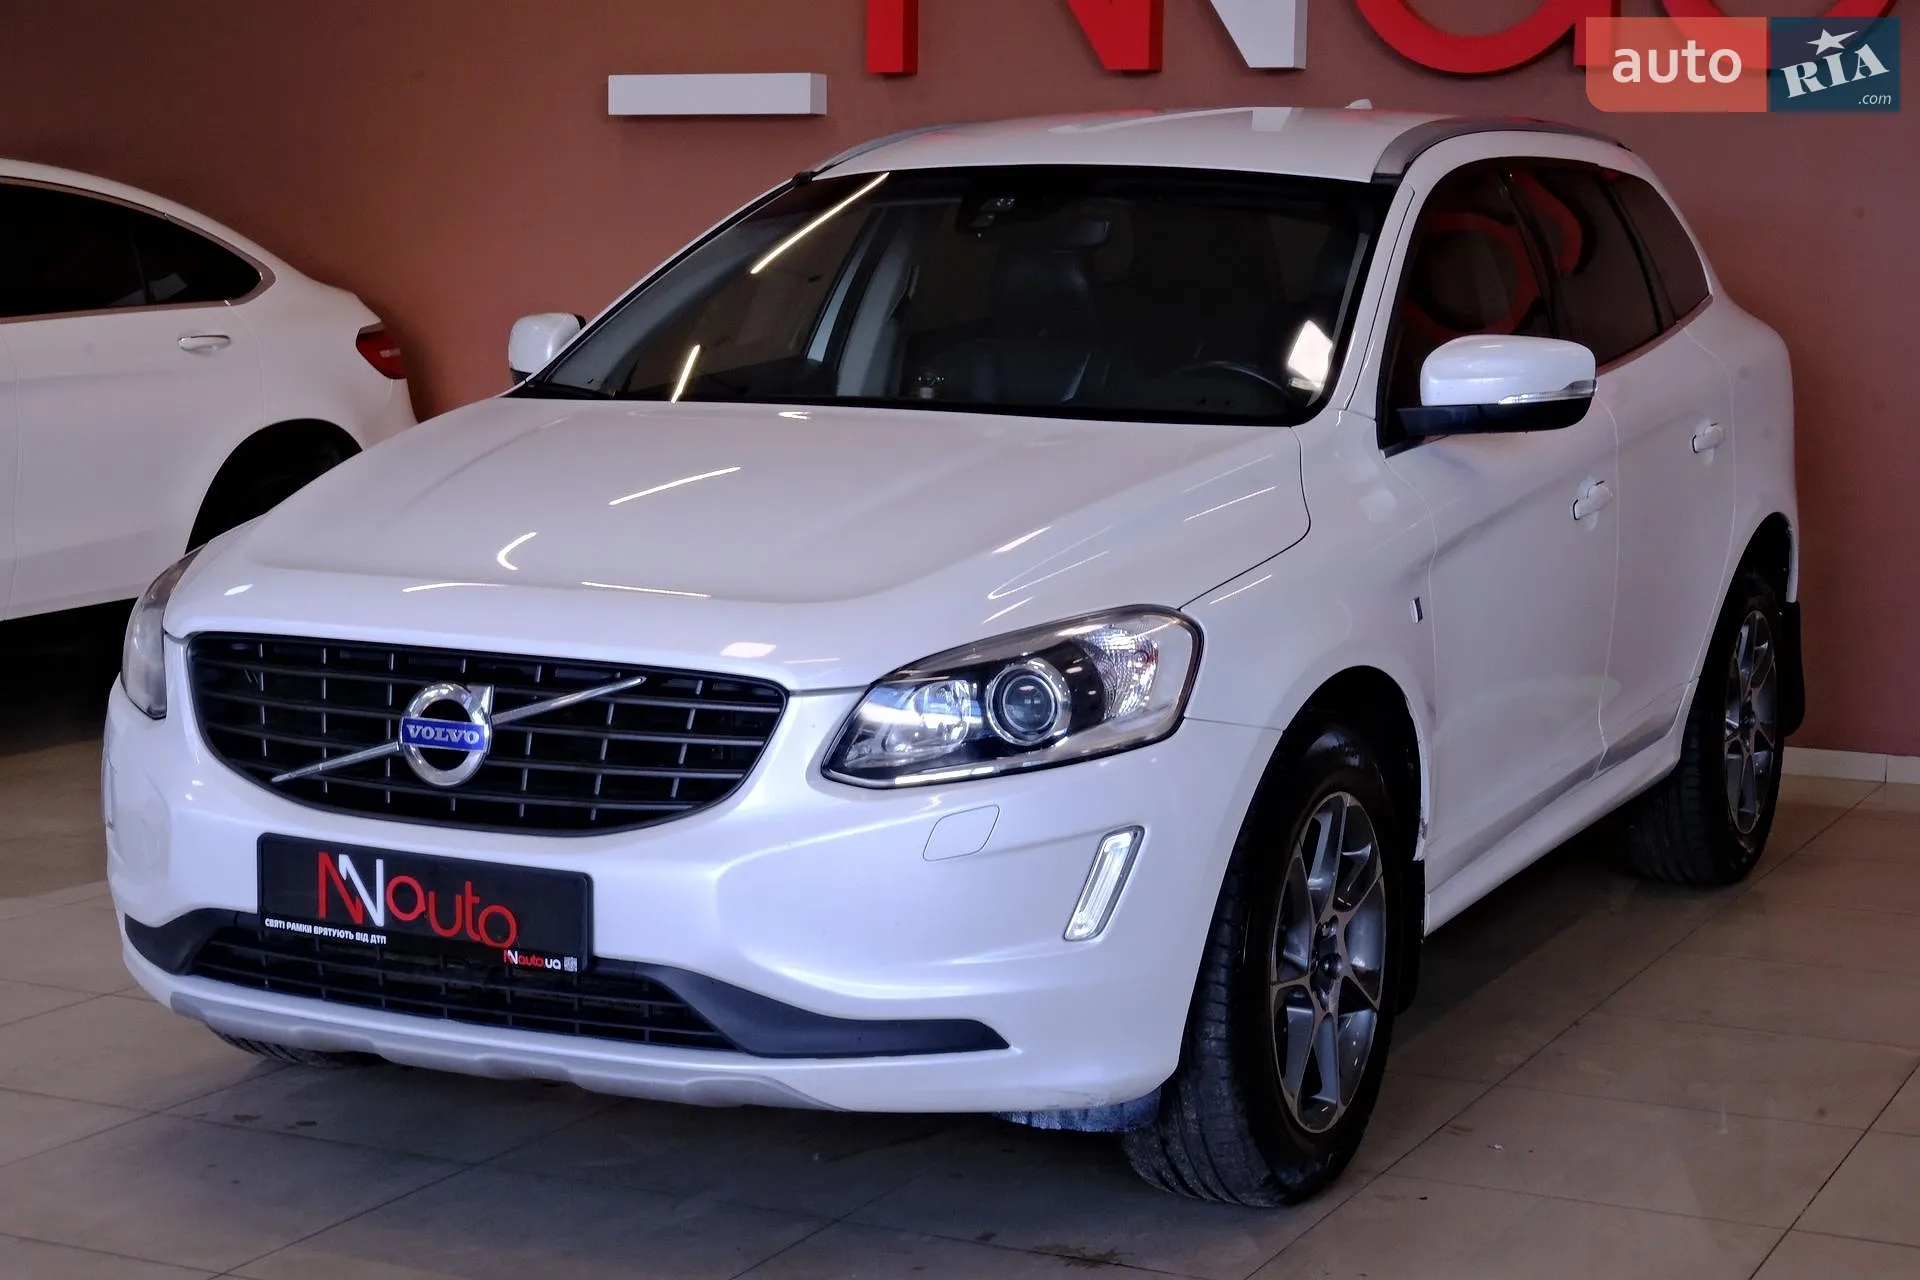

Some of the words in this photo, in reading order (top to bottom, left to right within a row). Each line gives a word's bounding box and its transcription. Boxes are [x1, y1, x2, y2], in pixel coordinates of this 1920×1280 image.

[407, 724, 480, 745] VOLVO
[265, 918, 286, 929] СВЯТІ
[286, 921, 312, 934] РАМКИ
[313, 925, 354, 940] ВРЯТУЮТЬ
[355, 931, 369, 943] ВІД
[370, 935, 387, 945] ДТП
